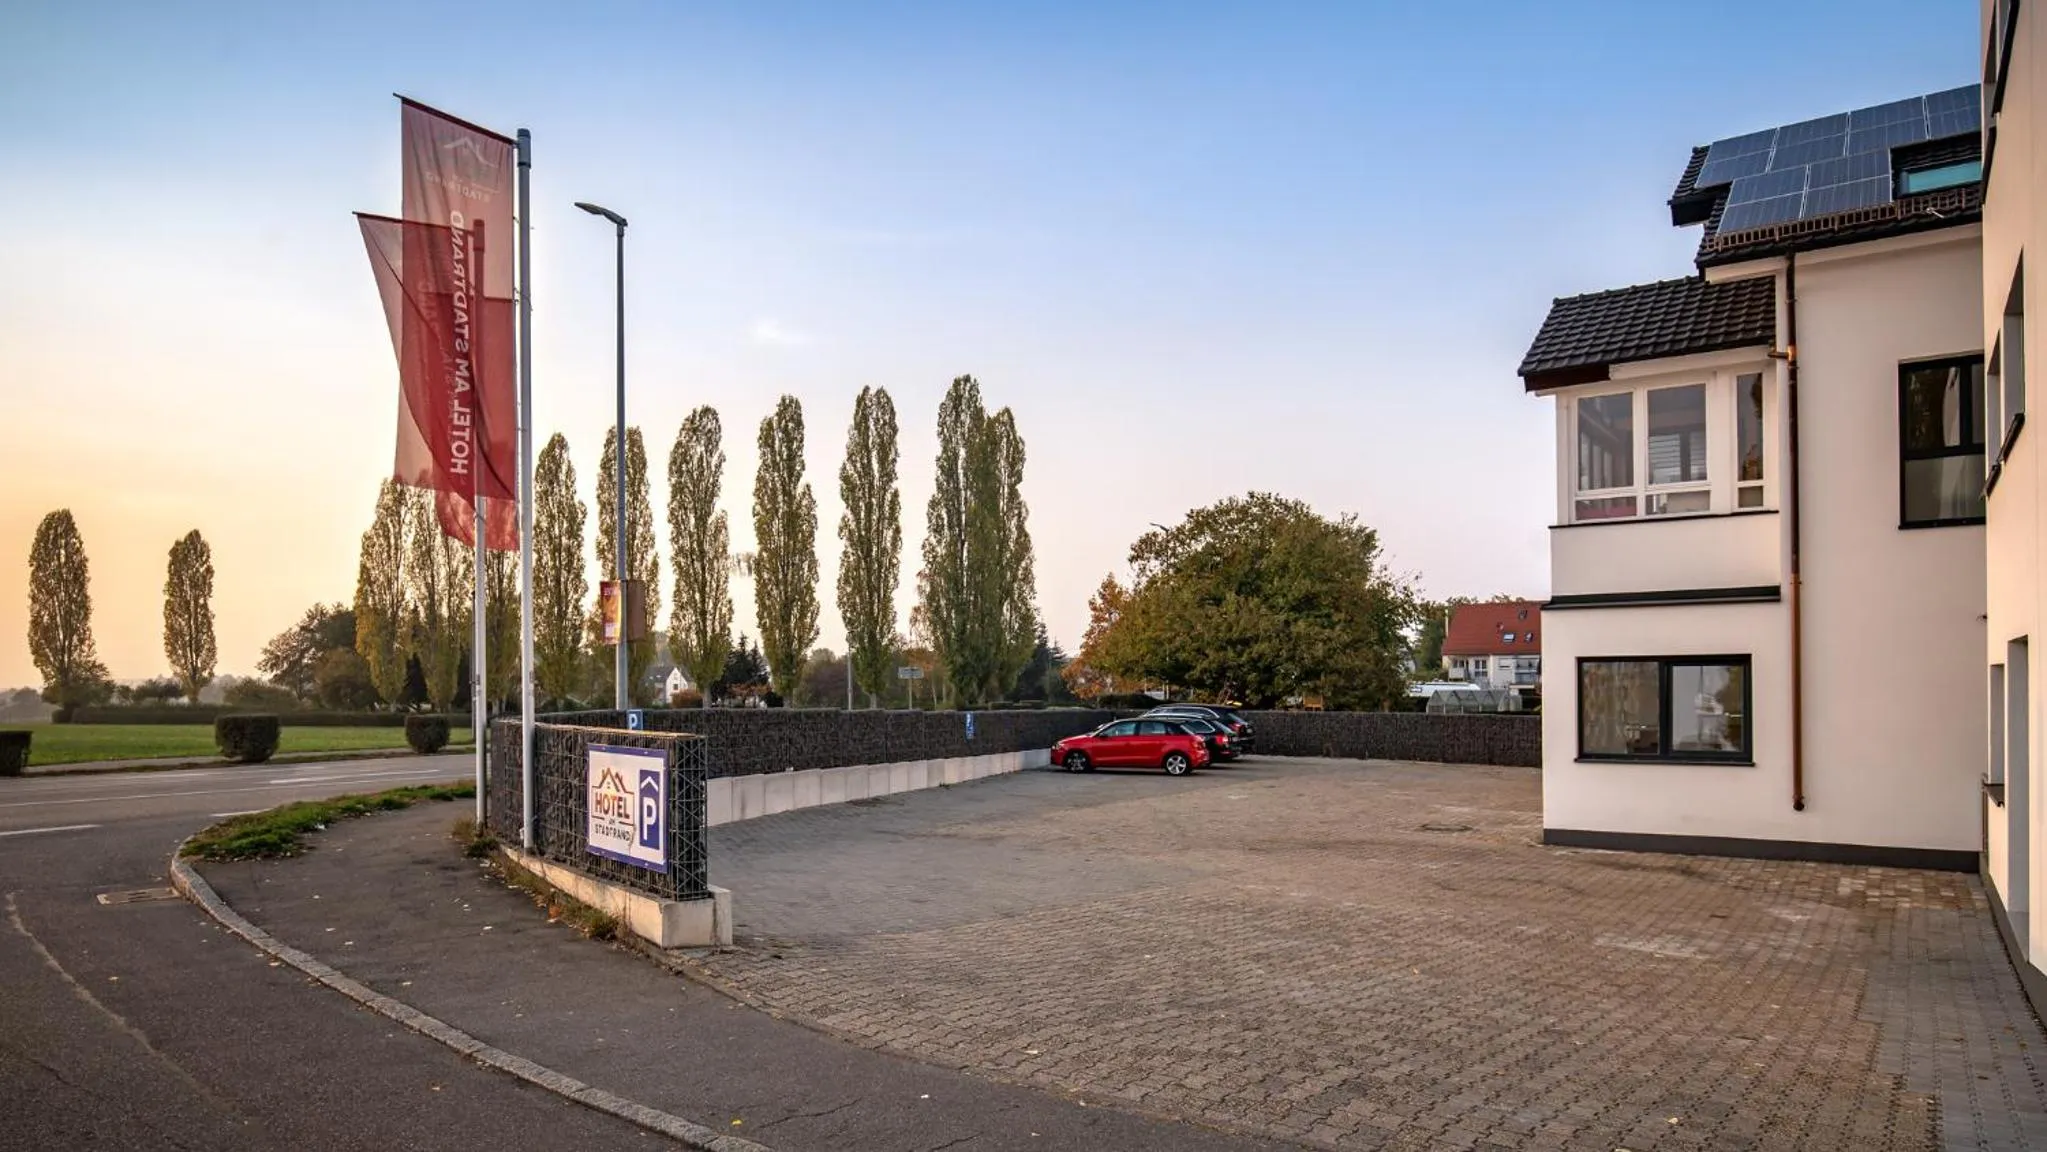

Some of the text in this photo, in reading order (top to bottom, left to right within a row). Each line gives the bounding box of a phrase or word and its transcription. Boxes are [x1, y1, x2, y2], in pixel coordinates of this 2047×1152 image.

[629, 713, 638, 730] P
[595, 792, 630, 819] HOTEL
[643, 796, 657, 841] P
[595, 823, 631, 842] STADTRAND
